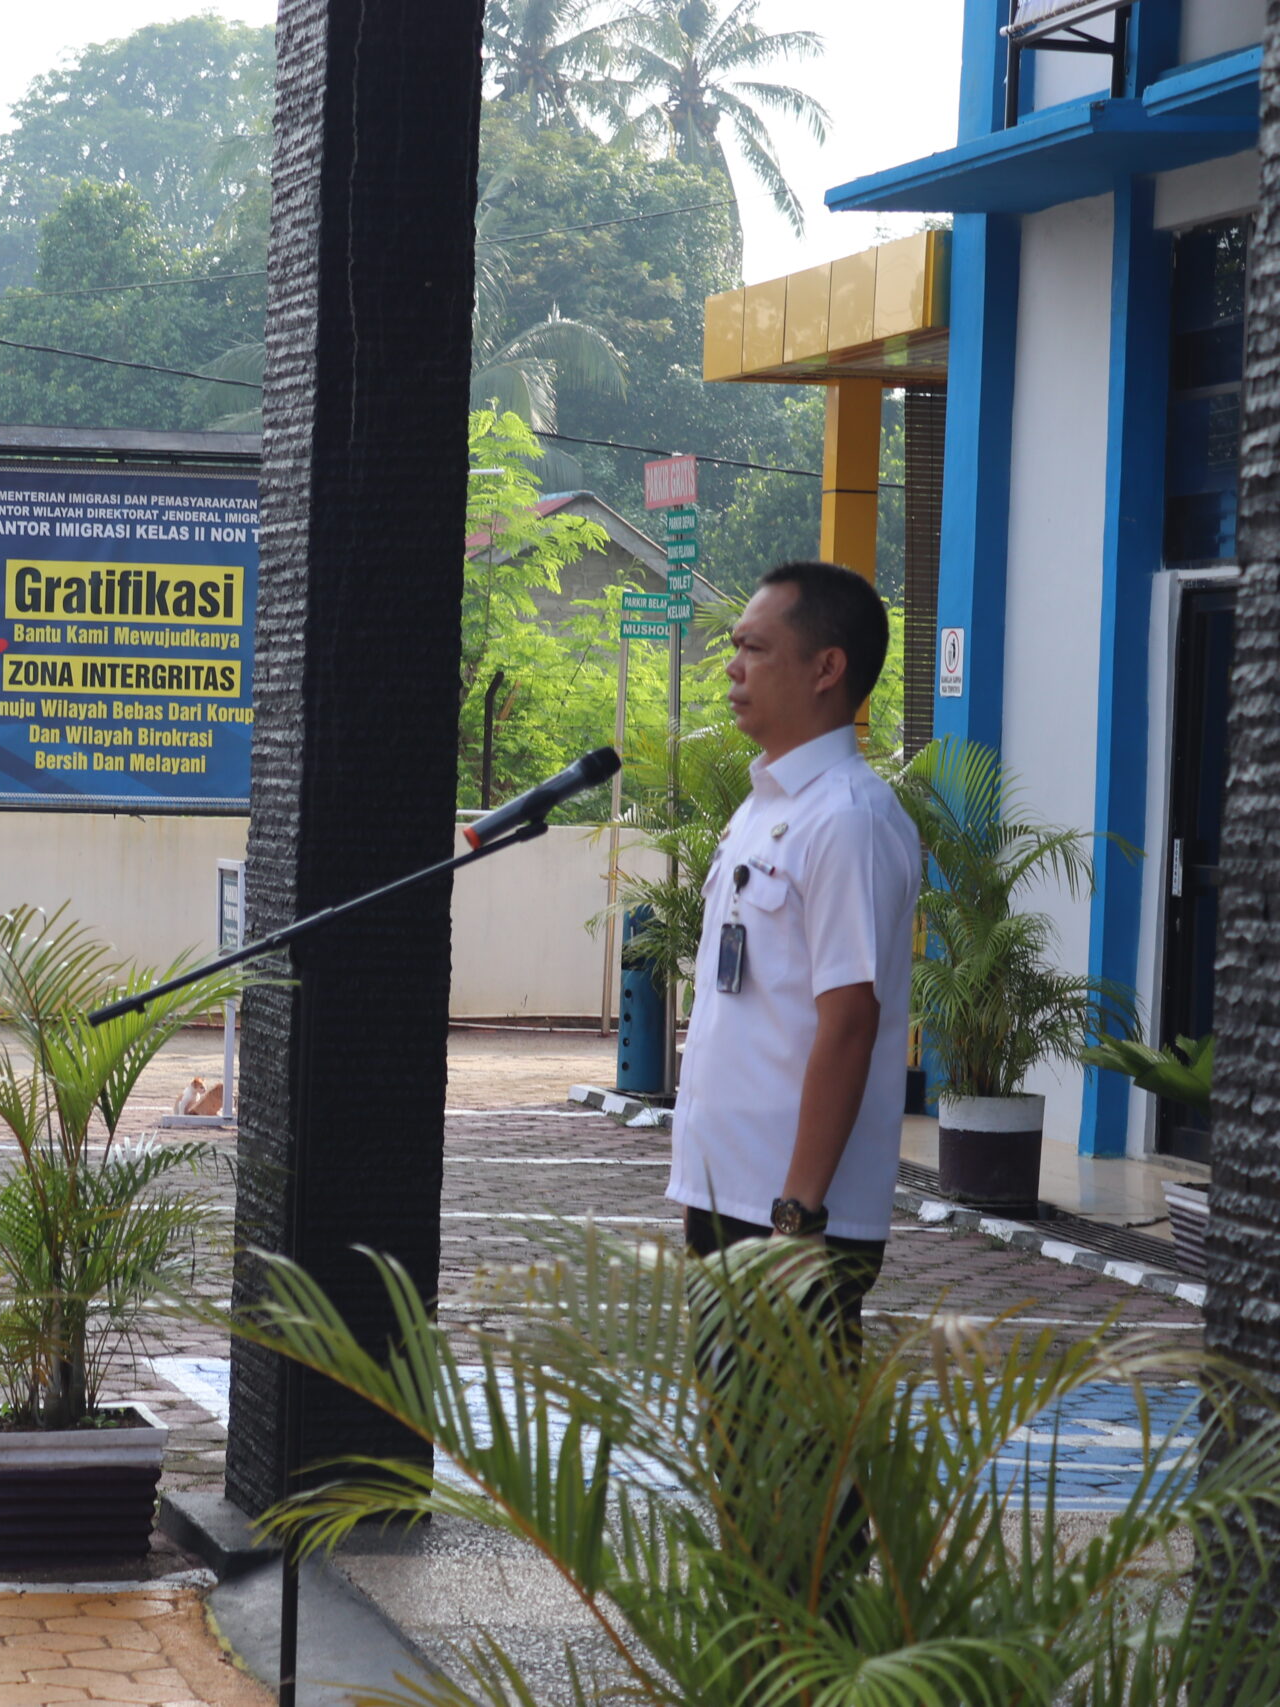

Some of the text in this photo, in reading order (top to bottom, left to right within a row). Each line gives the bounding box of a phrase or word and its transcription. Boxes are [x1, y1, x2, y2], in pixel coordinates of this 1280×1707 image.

[646, 463, 696, 502] PARKIR GRATIS
[68, 492, 121, 505] IMIGRASI
[124, 494, 148, 506] DAN
[150, 495, 258, 510] PEMASYARAKATAN
[32, 506, 84, 518] WILAYAH
[87, 508, 158, 520] DIREKTORAT
[162, 510, 222, 522] JENDERAL
[224, 512, 260, 524] IMIGR
[55, 522, 130, 539] IMIGRASI
[136, 524, 190, 540] KELAS
[195, 526, 205, 542] II
[210, 527, 246, 542] NON
[14, 566, 235, 618] Gratifikasi
[669, 574, 691, 591] TOILET
[624, 596, 647, 608] PARKIR
[668, 604, 690, 620] KELUAR
[14, 625, 240, 650] Bantu Kami Mewujudkanya
[623, 623, 670, 636] MUSHOL
[8, 660, 236, 692] ZONA INTERGRITAS
[41, 698, 108, 721] Wilayah
[112, 701, 163, 721] Bebas
[168, 702, 202, 722] Dari
[207, 704, 256, 725] Korup
[29, 724, 213, 748] Dan Wilayah Birokrasi
[35, 750, 206, 775] Bersih Dan Melayani
